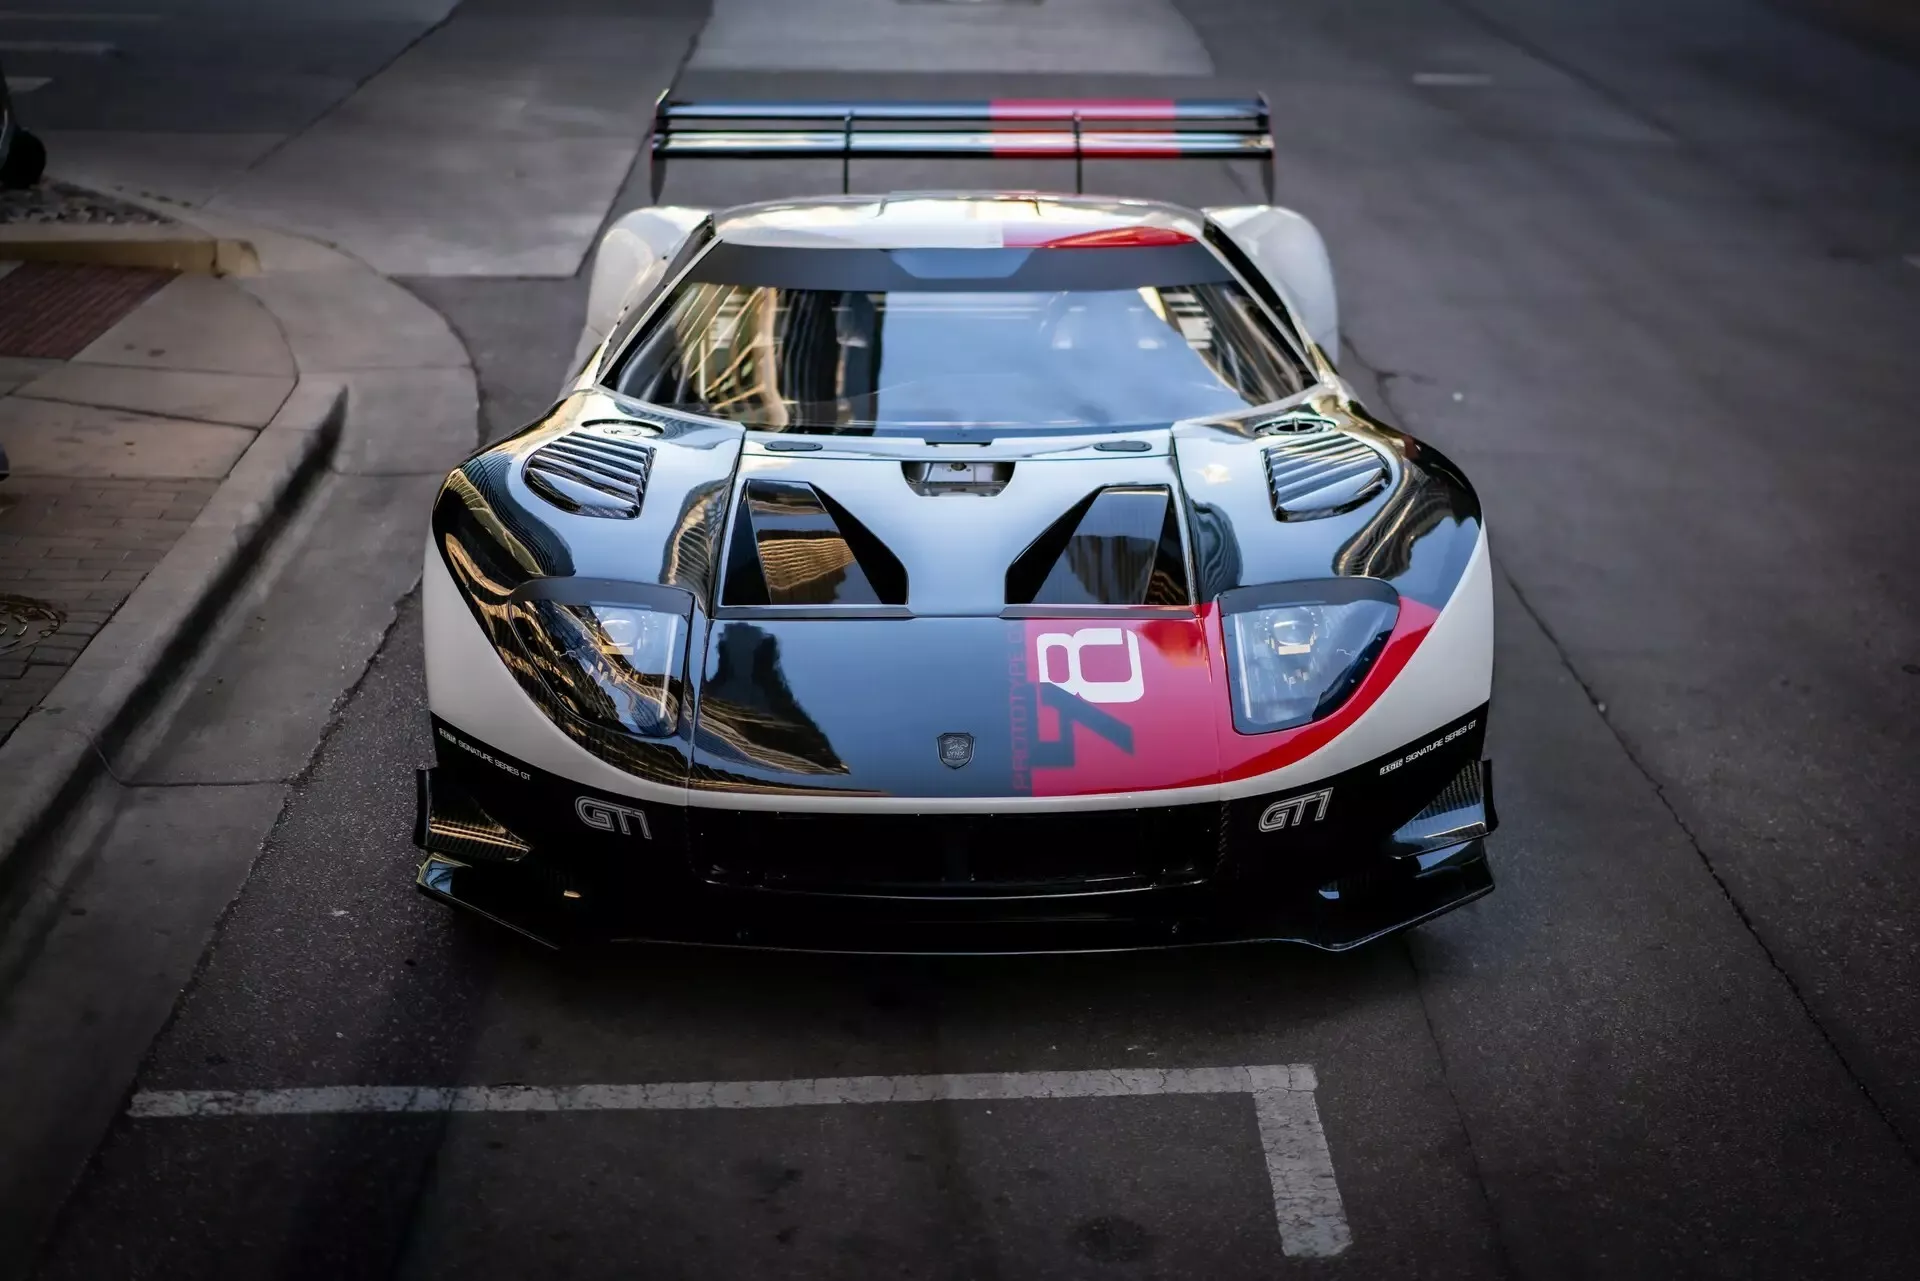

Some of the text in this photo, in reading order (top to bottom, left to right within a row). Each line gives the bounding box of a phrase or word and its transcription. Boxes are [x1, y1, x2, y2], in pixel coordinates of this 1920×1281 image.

[1405, 719, 1477, 763] SIGNATURE SERIES GT
[494, 759, 520, 776] SERIES
[520, 771, 531, 781] GT
